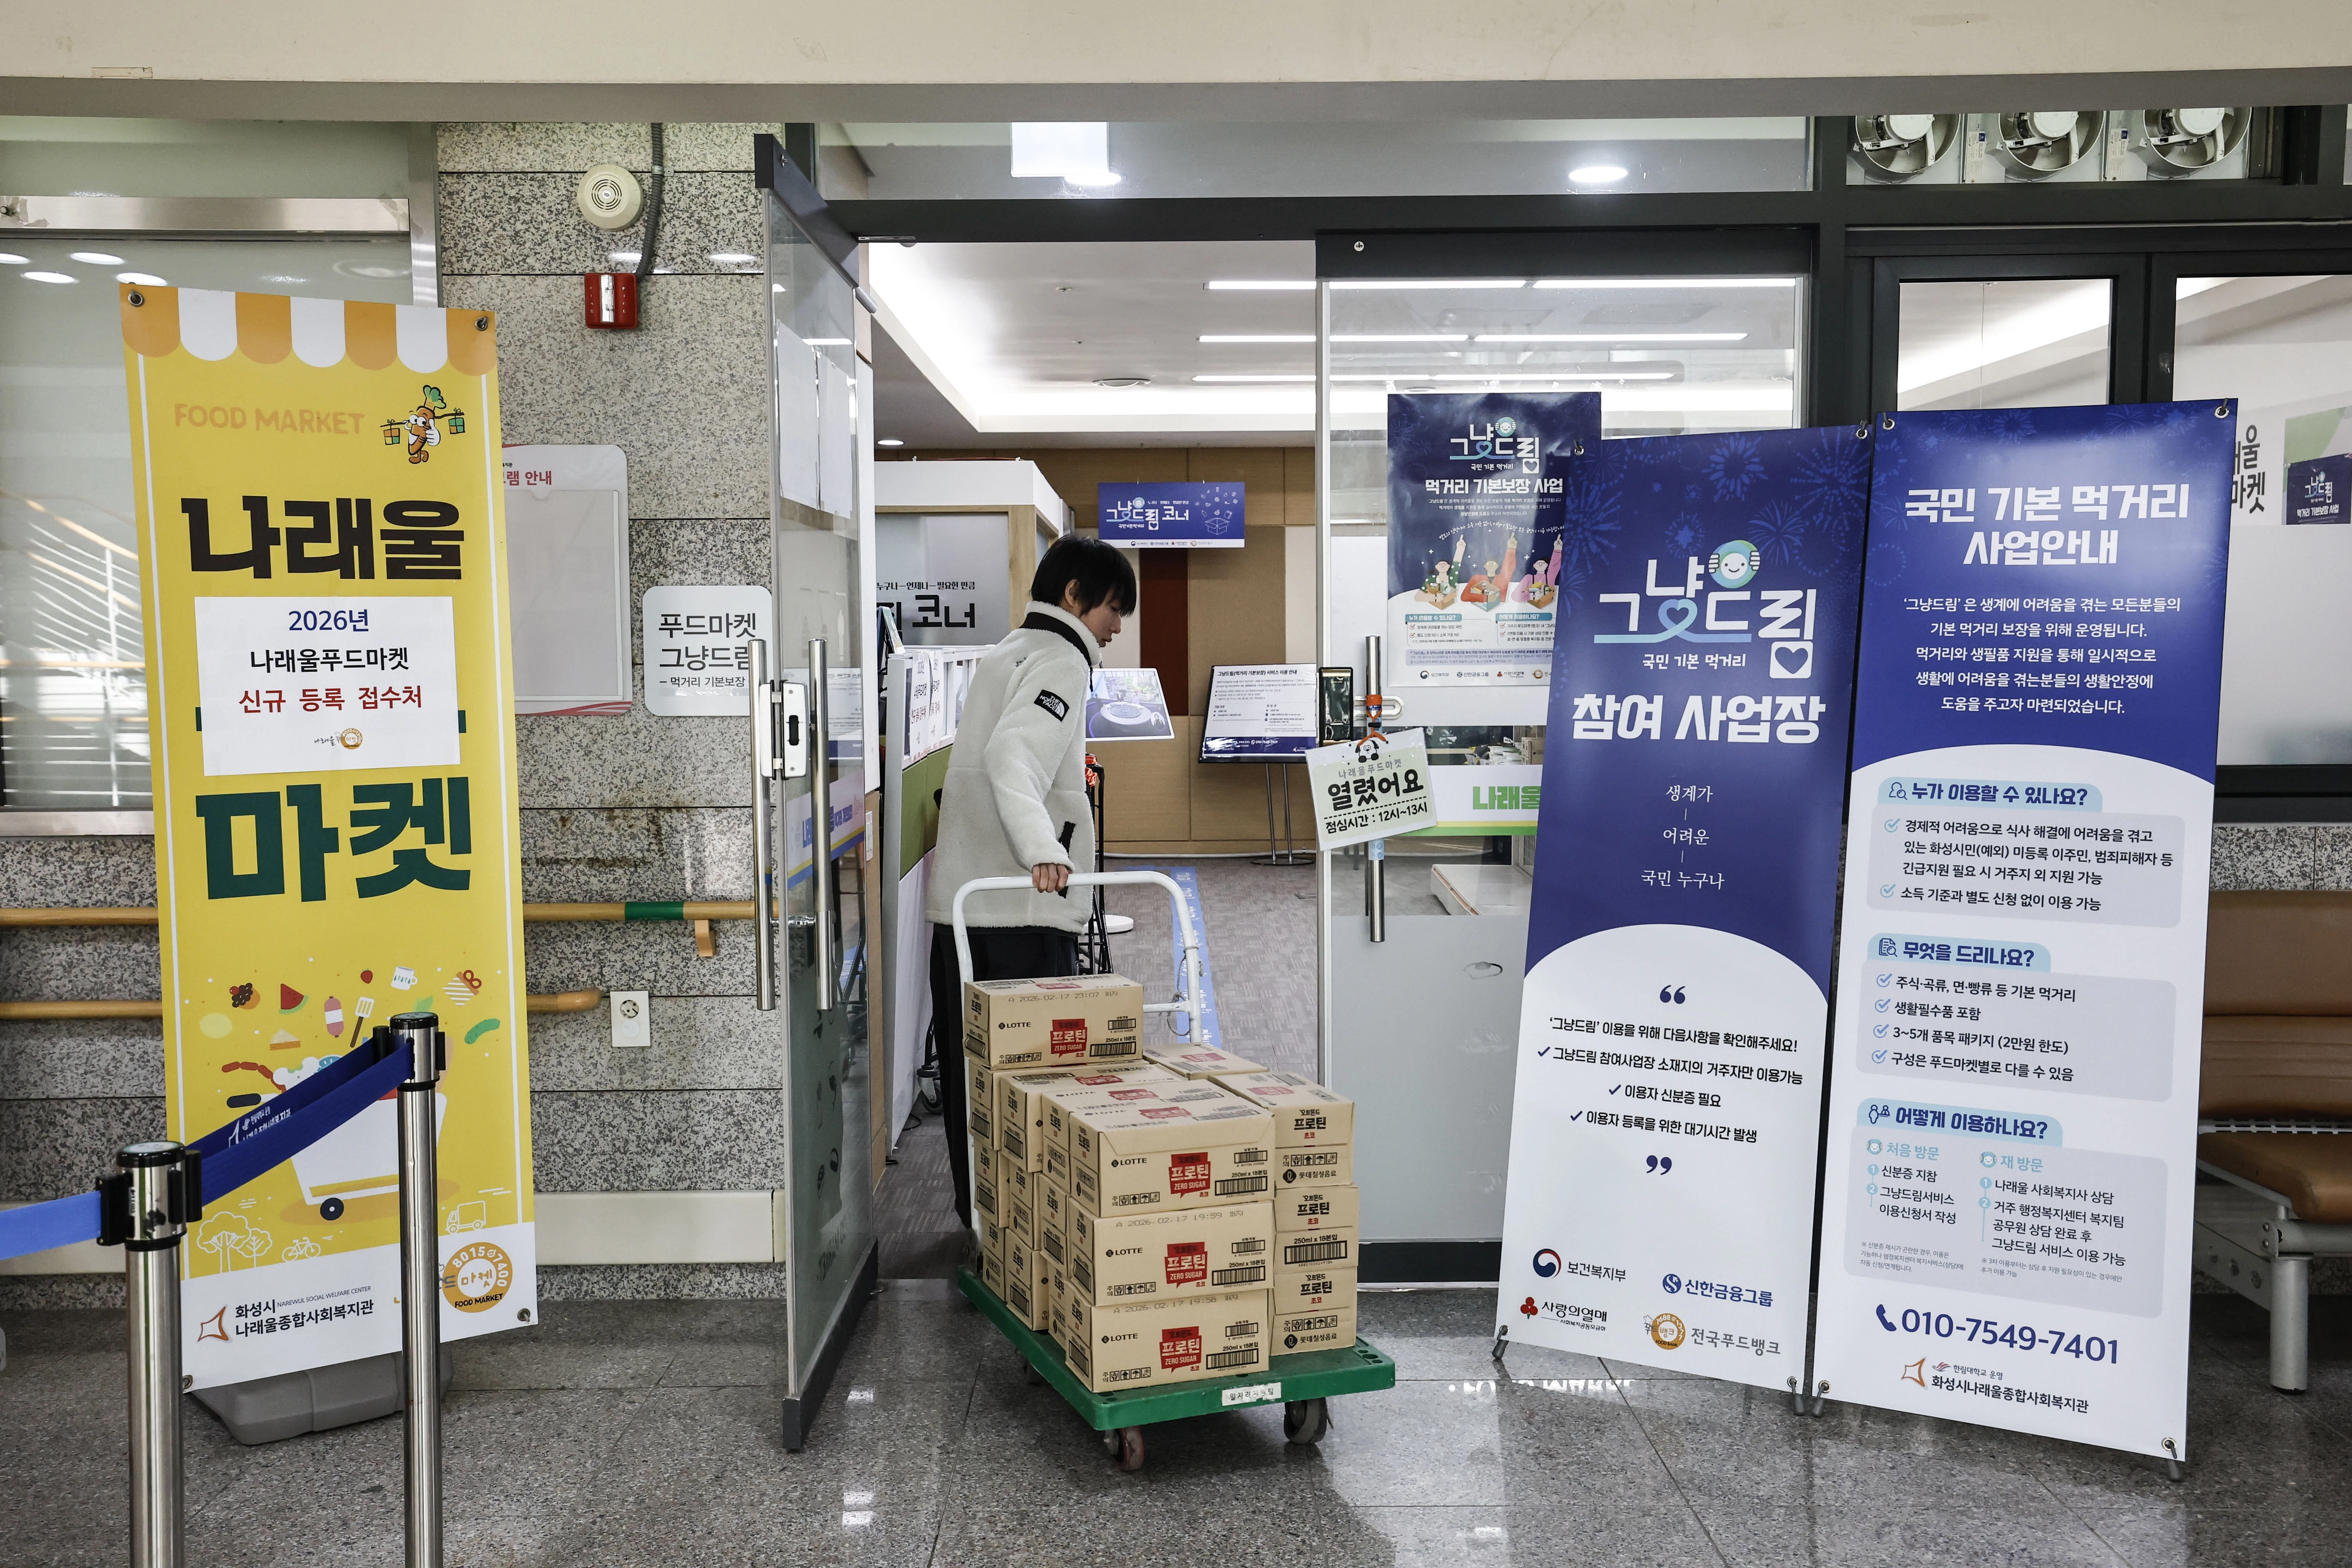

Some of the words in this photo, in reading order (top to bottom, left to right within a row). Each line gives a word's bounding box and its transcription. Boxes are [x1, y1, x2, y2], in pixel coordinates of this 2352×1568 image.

[174, 404, 247, 429] FOOD
[255, 407, 365, 435] MARKET
[1449, 422, 1539, 474] 그냥드림
[525, 470, 552, 486] 안내
[1425, 479, 1469, 494] 먹거리
[1474, 478, 1531, 494] 기본보장
[1534, 477, 1563, 494] 사업
[1162, 506, 1189, 520] 코너
[1905, 488, 1976, 523] 국민
[1987, 486, 2062, 521] 기본
[2072, 483, 2189, 520] 먹거리
[181, 495, 465, 580] 나래울
[1963, 530, 2119, 566] 사업안내
[961, 581, 975, 590] 만큼
[911, 594, 975, 628] 코너
[1963, 598, 1977, 612] 은
[1980, 597, 2020, 612] 생계에
[2023, 597, 2077, 613] 어려움을
[2080, 597, 2108, 613] 겪는
[2110, 597, 2180, 613] 모든분들의
[289, 609, 369, 632] 2026년
[658, 613, 757, 639] 푸드마켓
[1593, 556, 1816, 679] 그냥드림
[250, 647, 409, 673] 나래울푸드마켓
[1642, 654, 1669, 670] 국민
[1673, 653, 1699, 670] 기본
[1705, 653, 1746, 670] 먹거리
[670, 676, 700, 688] 먹거리
[704, 676, 745, 688] 기본보장
[239, 690, 286, 714] 신규
[299, 688, 345, 712] 등록
[358, 685, 422, 710] 접수처
[1040, 696, 1058, 707] NORTH
[1043, 701, 1056, 710] FACE
[1572, 693, 1663, 740] 참여
[1674, 695, 1826, 744] 사업장
[1338, 759, 1402, 779] 나래울푸드마켓
[1328, 768, 1424, 811] 열렸어요
[1473, 786, 1541, 810] 나래울
[1665, 784, 1713, 803] 생계가
[1912, 783, 1944, 800] 누가
[1948, 784, 1999, 802] 이용할
[2003, 786, 2020, 803] 수
[2024, 787, 2088, 805] 있나요?
[1325, 815, 1369, 834] 점심시간
[1378, 801, 1428, 823] 12시~13시
[195, 776, 472, 902] 마켓
[1663, 827, 1710, 845] 어려운
[1905, 820, 1940, 834] 경제적
[1943, 821, 2003, 835] 어려움으로
[2006, 824, 2031, 838] 식사
[2033, 825, 2070, 840] 해결에
[2074, 827, 2124, 842] 어려움을
[2127, 830, 2153, 843] 겪고
[1641, 870, 1671, 887] 국민
[1677, 871, 1725, 890] 누구나
[1900, 887, 1925, 901] 소득
[1927, 888, 1963, 903] 기준과
[1966, 891, 1990, 904] 별도
[1993, 892, 2017, 906] 신청
[2020, 894, 2044, 908] 없이
[2048, 895, 2073, 910] 이용
[2076, 897, 2102, 911] 가능
[1903, 941, 1952, 961] 무엇을
[1956, 945, 2034, 967] 드리나요?
[1020, 994, 1069, 1002] 2026.02.17
[1053, 1029, 1086, 1044] 프로틴
[1602, 1022, 1635, 1037] 이용을
[1638, 1025, 1661, 1040] 위해
[1663, 1028, 1720, 1045] 다음사항을
[1723, 1032, 1798, 1052] 확인해주세요!
[1553, 1047, 1597, 1064] 그냥드림
[1599, 1051, 1656, 1069] 참여사업장
[1658, 1058, 1703, 1075] 소재지의
[1706, 1062, 1754, 1080] 거주자만
[1756, 1068, 1803, 1085] 이용가능
[1294, 1116, 1326, 1130] 프로틴
[1895, 1107, 1946, 1128] 어떻게
[1950, 1113, 2048, 1139] 이용하나요?
[1886, 1142, 1912, 1158] 처음
[1915, 1145, 1940, 1161] 방문
[1299, 1171, 1337, 1179] 롯데칠성음료
[1882, 1165, 1913, 1180] 신분증
[1916, 1169, 1937, 1183] 지참
[2000, 1155, 2014, 1169] 재
[2017, 1156, 2044, 1173] 방문
[1294, 1236, 1312, 1245] 250ml
[1868, 1242, 1884, 1251] 신분증
[1885, 1243, 1902, 1252] 제시가
[1933, 1249, 1949, 1259] 이용은
[452, 1246, 486, 1268] 8015
[493, 1253, 509, 1287] 7400
[1567, 1261, 1626, 1282] 보건복지부
[462, 1269, 492, 1288] 마켓
[276, 1297, 306, 1308] NAREWUL
[306, 1293, 325, 1304] SOCIAL
[325, 1289, 350, 1300] WELFARE
[350, 1285, 372, 1295] CENTER
[455, 1299, 473, 1308] FOOD
[475, 1293, 503, 1305] MARKET
[1685, 1279, 1773, 1308] 신한금융그룹
[235, 1299, 276, 1319] 화성시
[236, 1299, 374, 1338] 나래울종합사회복지관
[1541, 1301, 1608, 1323] 사랑의열매
[1111, 1333, 1138, 1342] LOTTE
[1161, 1338, 1201, 1357] 프로틴
[1691, 1328, 1780, 1356] 전국푸드뱅크
[1902, 1309, 2117, 1364] 010-7549-7401
[1165, 1357, 1178, 1365] ZERO
[1180, 1355, 1197, 1363] SUGAR
[1953, 1365, 1987, 1377] 한림대학교
[1989, 1370, 2003, 1380] 운영
[1931, 1375, 2089, 1414] 화성시나래울종합사회복지관
